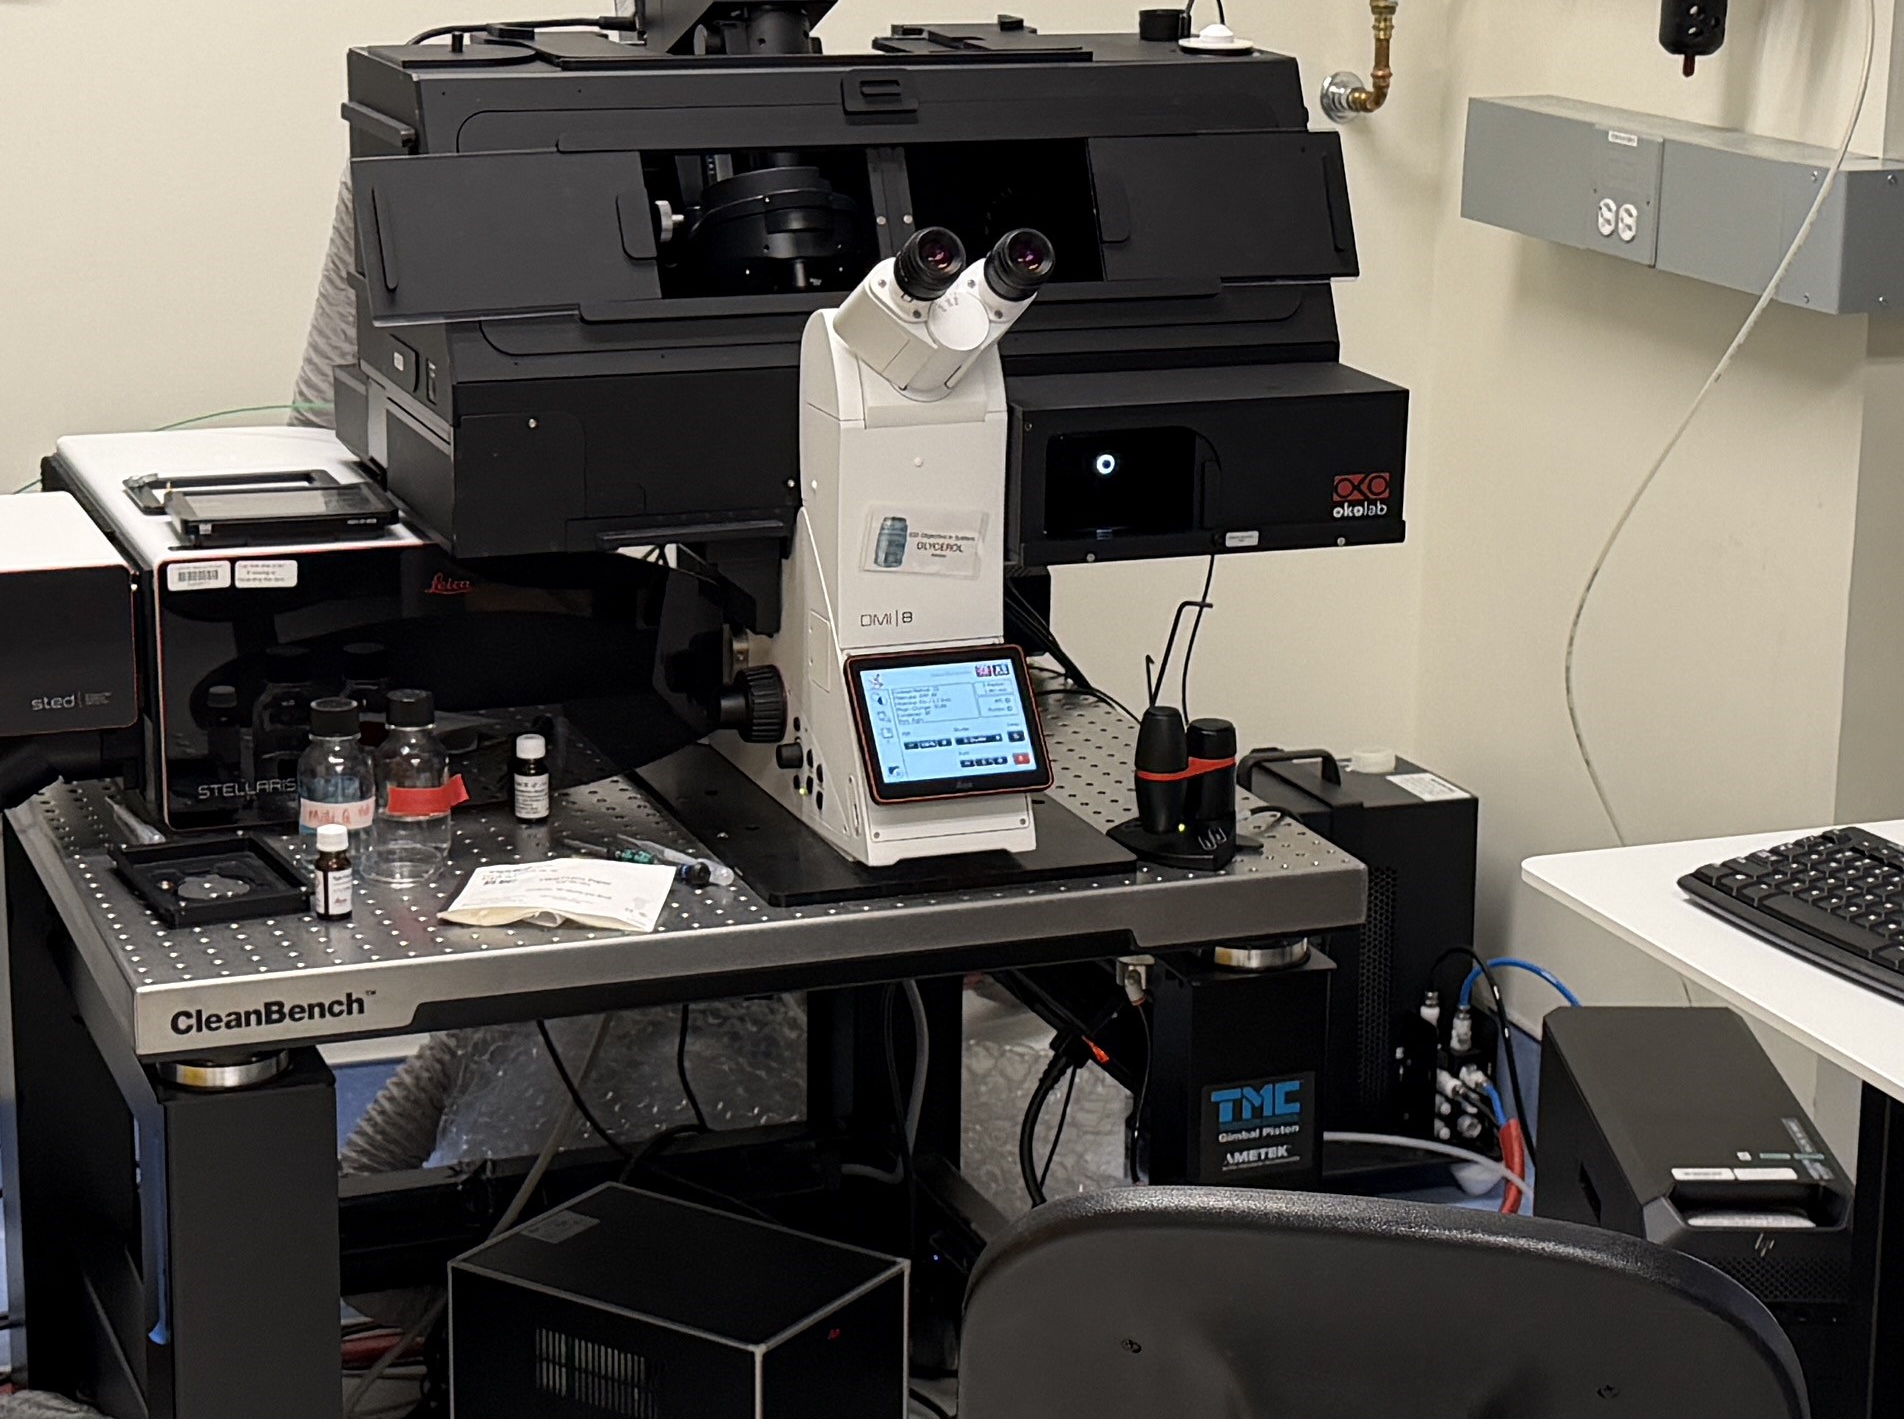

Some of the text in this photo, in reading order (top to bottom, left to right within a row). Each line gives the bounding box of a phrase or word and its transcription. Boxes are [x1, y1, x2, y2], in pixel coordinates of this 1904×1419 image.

[1332, 500, 1388, 518] okolab
[916, 541, 964, 553] GLYCEROL
[31, 693, 75, 711] sted
[198, 777, 296, 799] STELLARIS
[1211, 1080, 1301, 1123] TMC
[1218, 1125, 1300, 1143] Gimbal Piston
[1224, 1144, 1288, 1165] AMETEK
